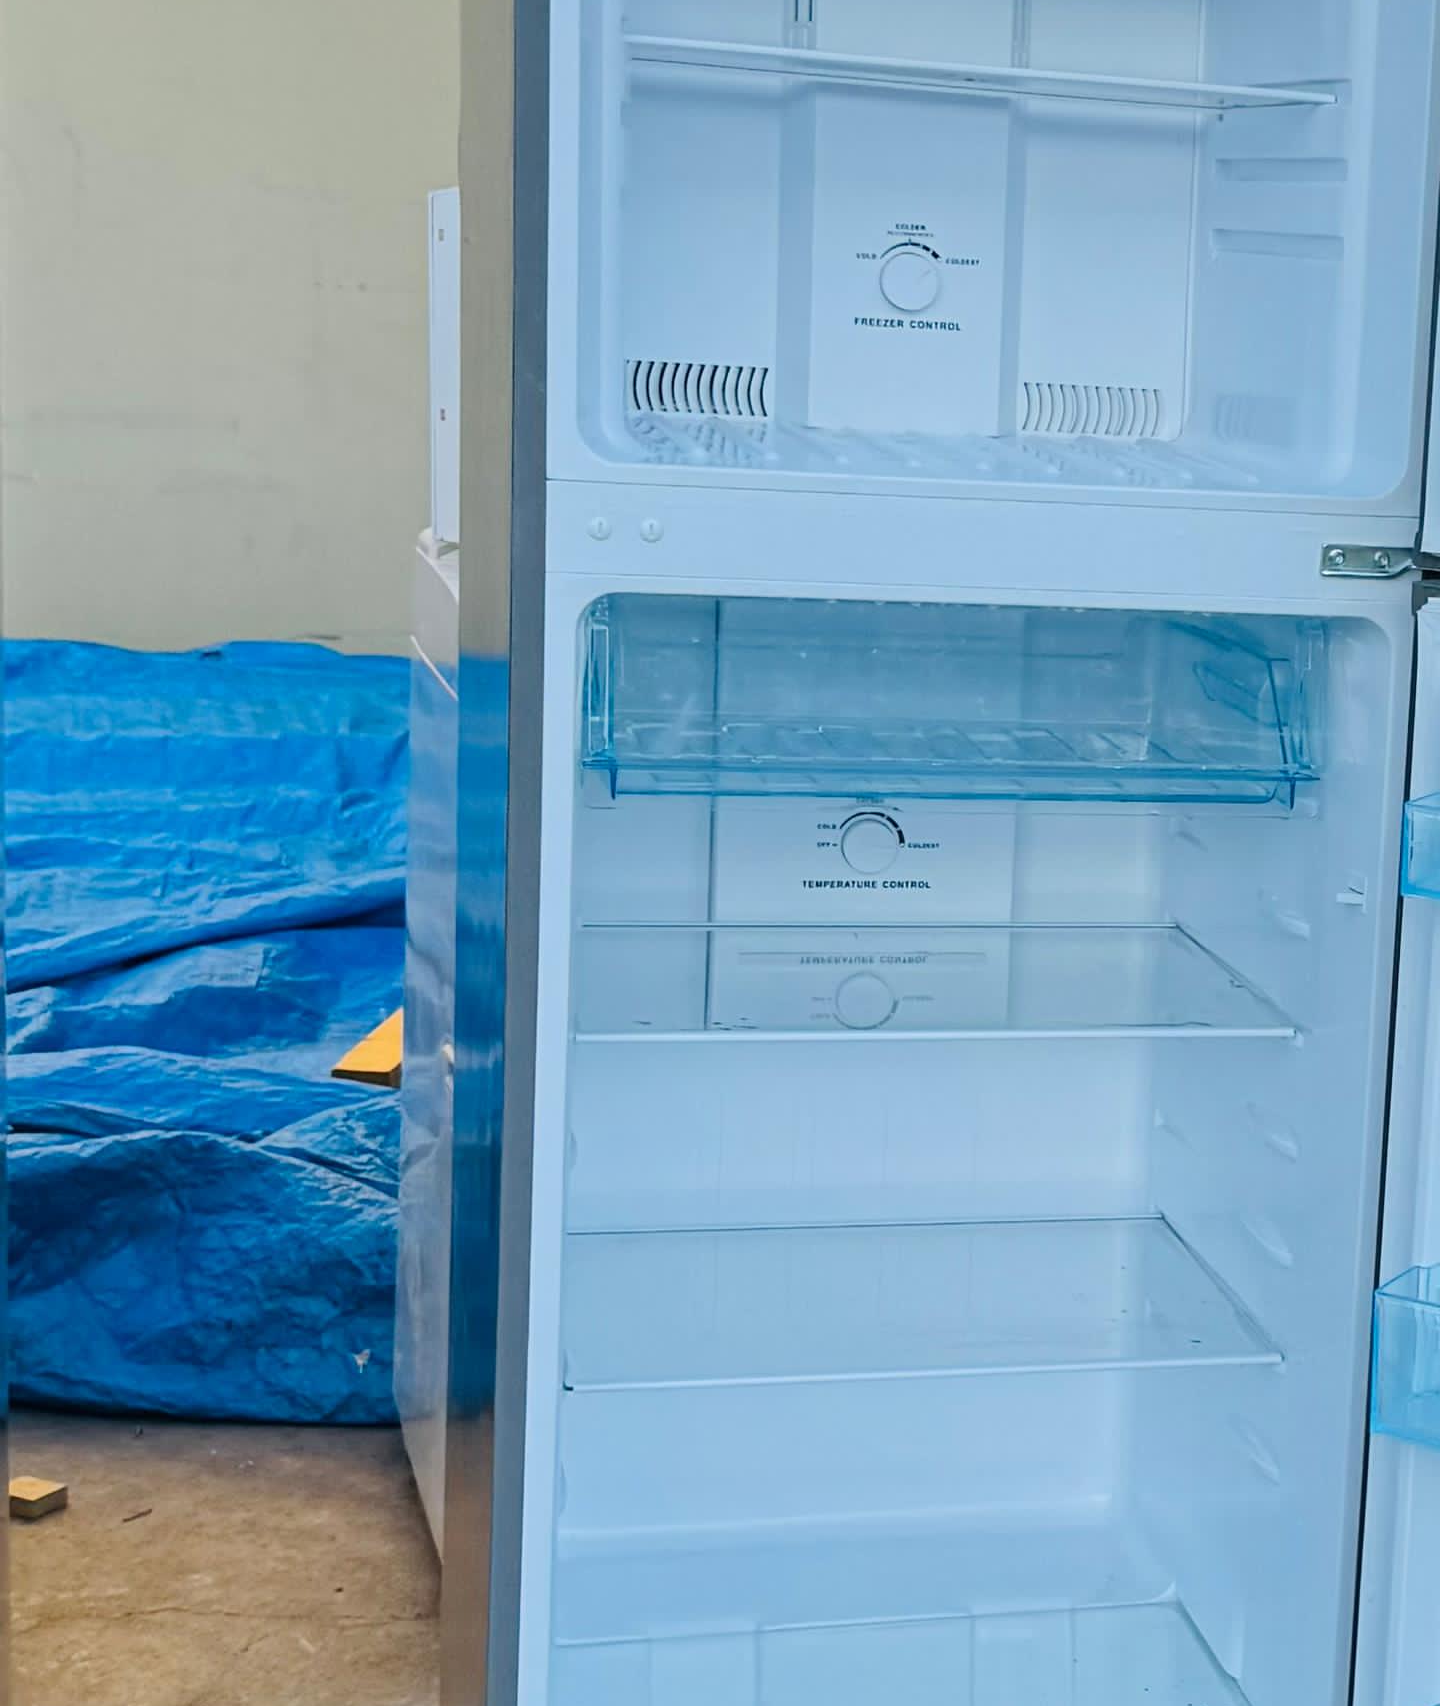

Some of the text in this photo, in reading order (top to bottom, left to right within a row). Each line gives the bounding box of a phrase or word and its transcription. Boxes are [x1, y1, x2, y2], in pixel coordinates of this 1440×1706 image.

[854, 316, 961, 332] FREEZER CONTROL
[802, 879, 931, 889] TEMPERATURE CONTROL
